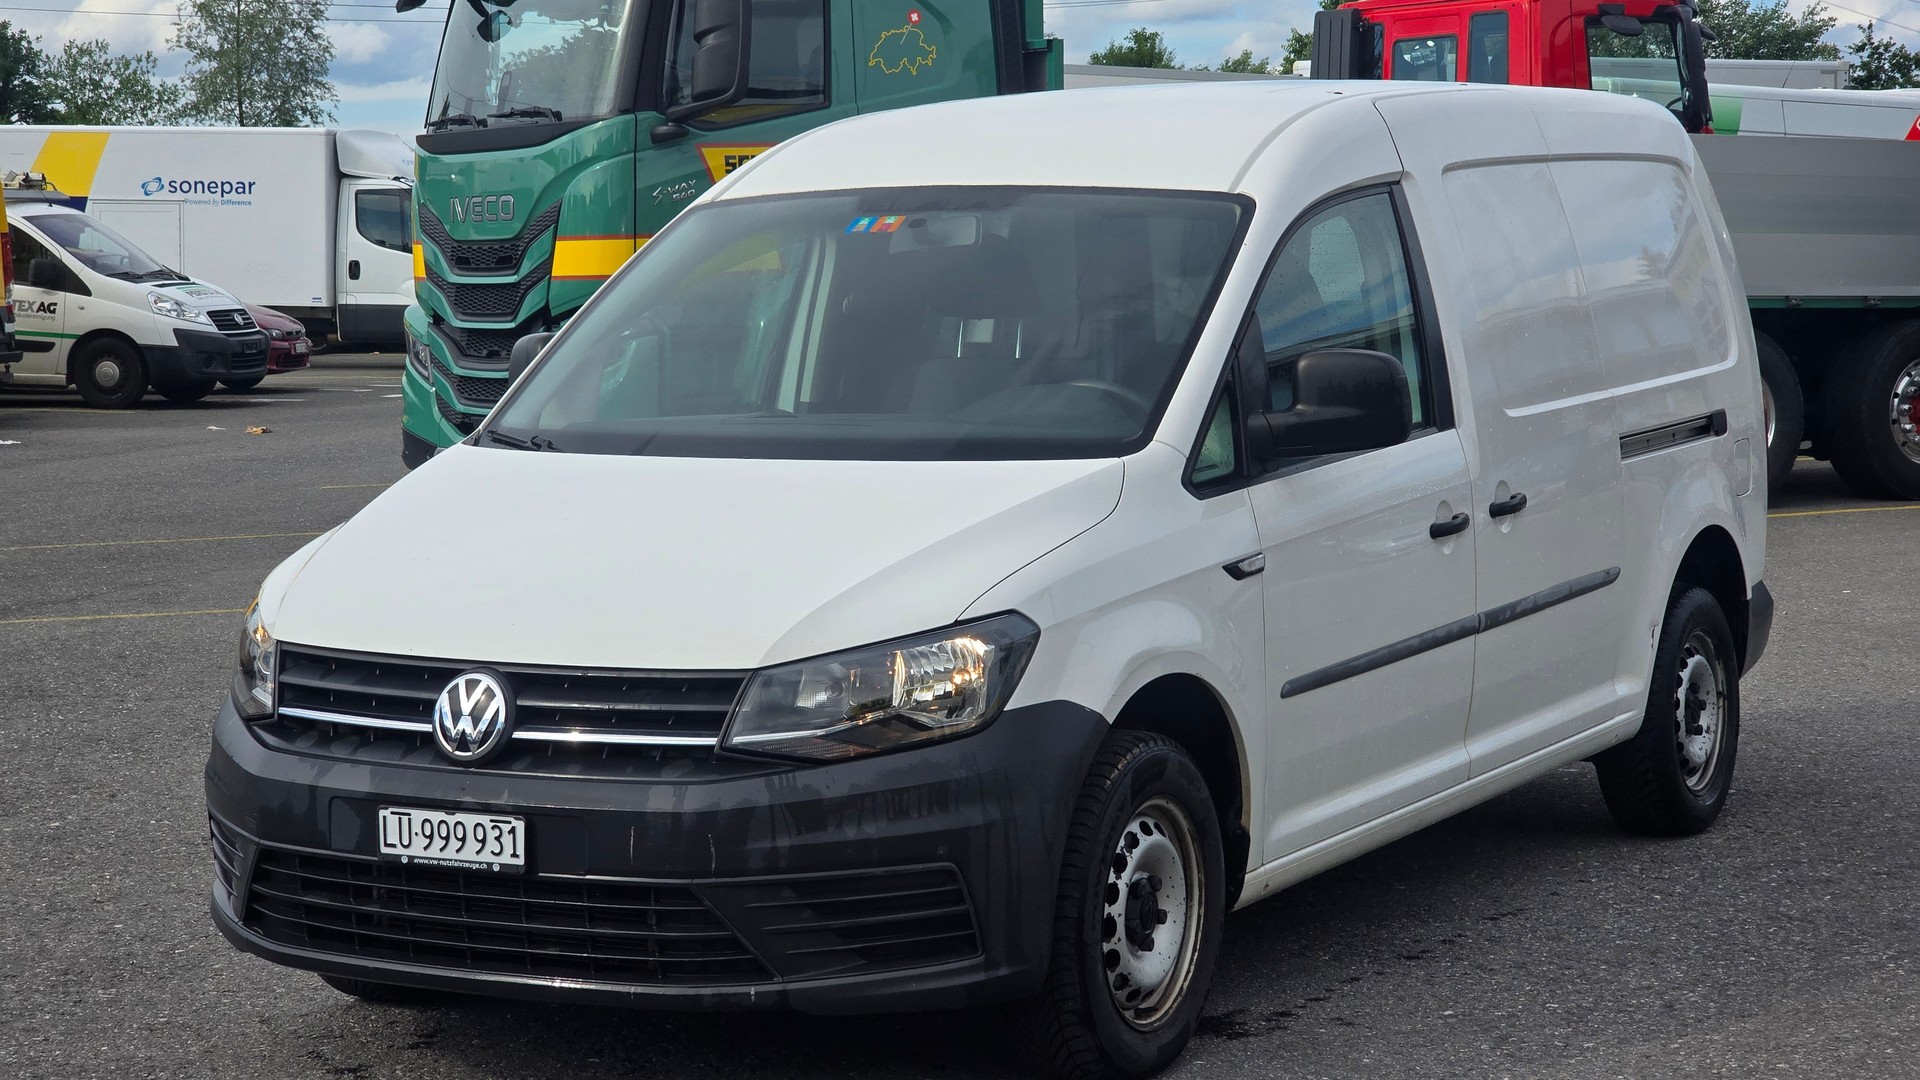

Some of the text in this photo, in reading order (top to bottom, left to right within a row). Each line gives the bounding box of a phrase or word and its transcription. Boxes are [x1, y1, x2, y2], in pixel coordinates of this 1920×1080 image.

[168, 180, 256, 198] sonepar
[652, 179, 696, 205] S-WAY
[184, 198, 211, 206] Powered
[212, 198, 219, 207] by
[450, 194, 515, 224] IVECO
[36, 301, 58, 315] AG
[434, 673, 507, 757] VW
[413, 857, 488, 870] www.vw-nutzfahrzeuge.ch
